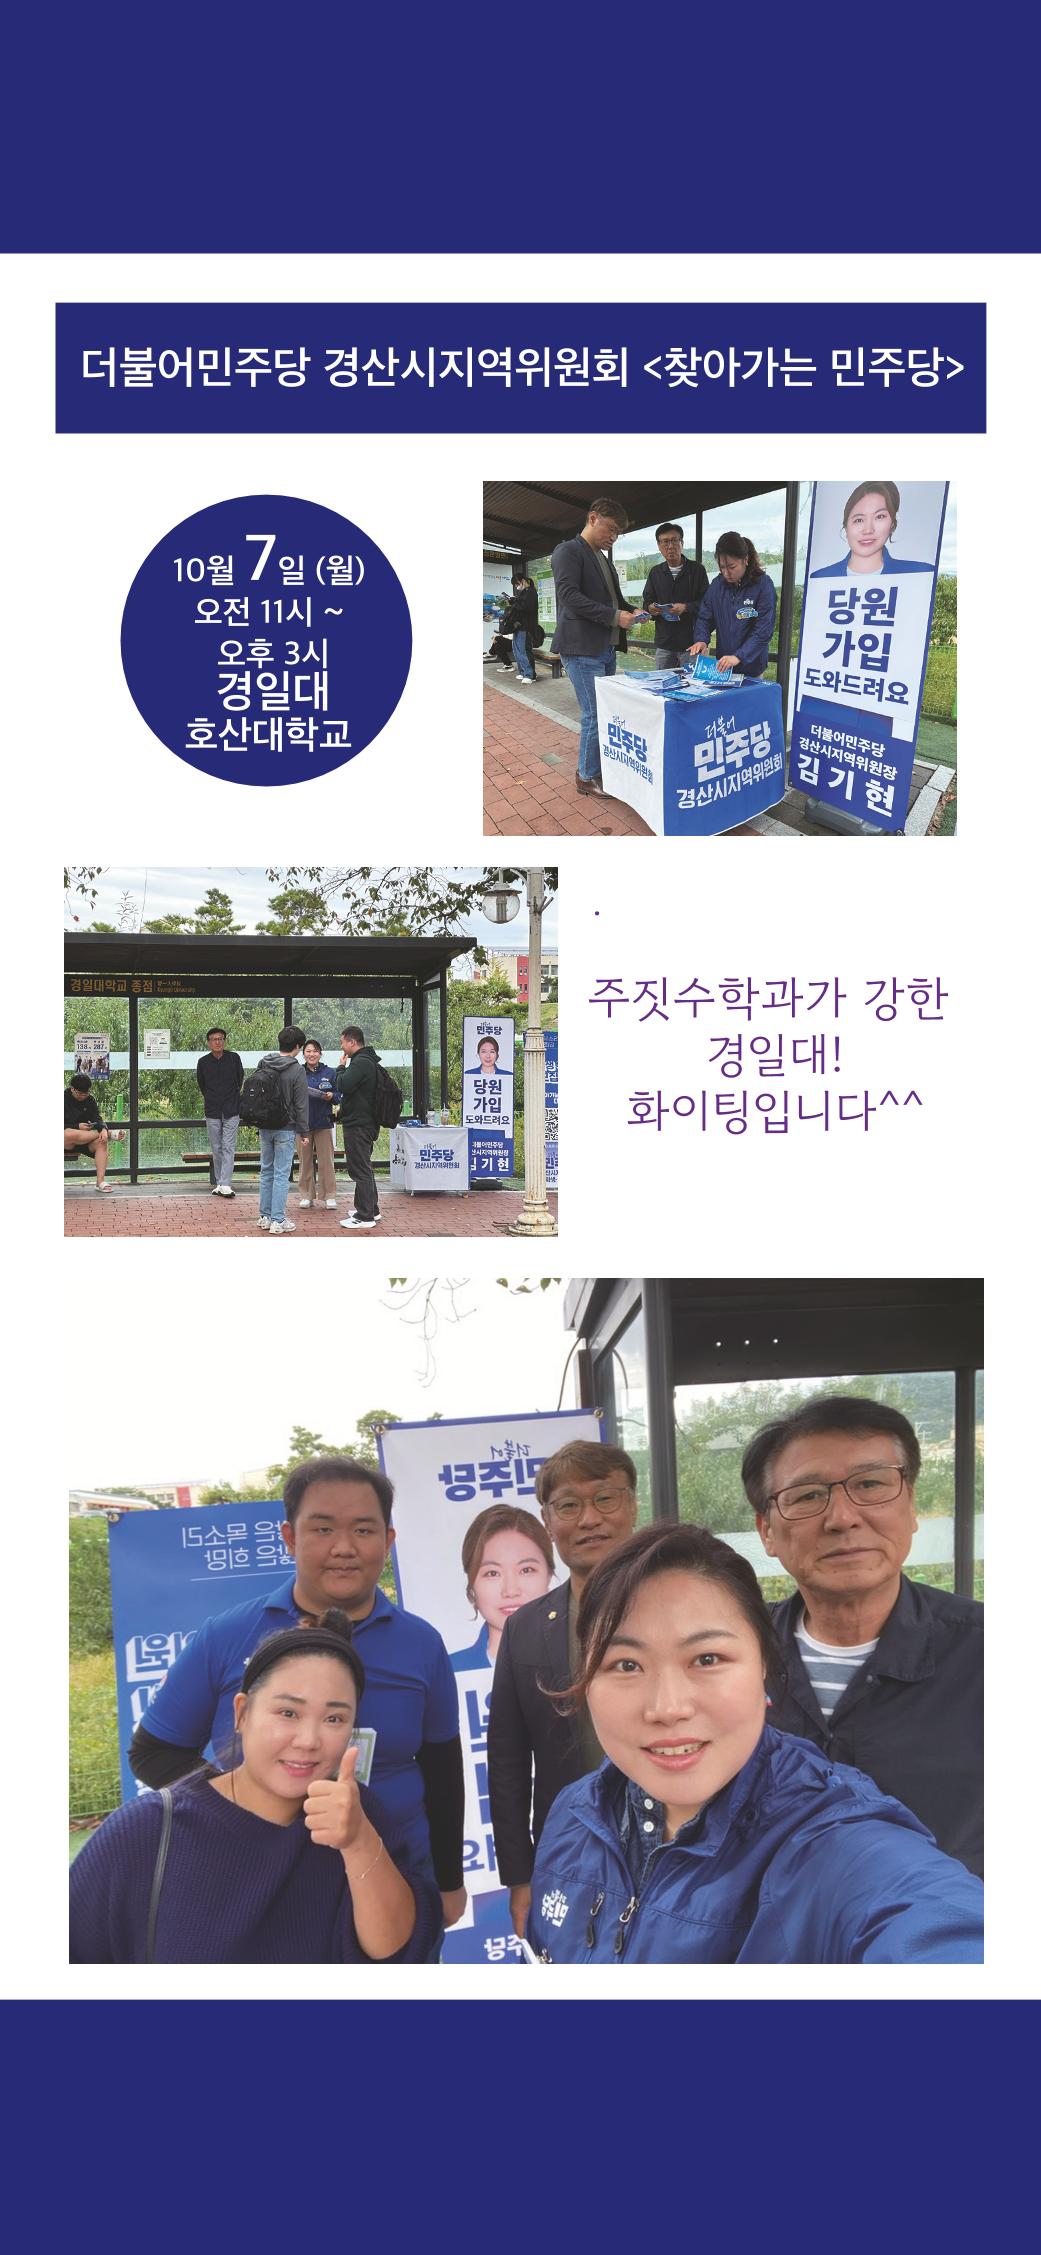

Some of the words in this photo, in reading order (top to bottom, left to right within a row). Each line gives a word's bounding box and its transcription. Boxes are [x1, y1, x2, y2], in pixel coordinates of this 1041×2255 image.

[829, 587, 898, 626] 당원
[822, 630, 892, 673] 가입
[803, 668, 909, 705] 도와드려요
[607, 722, 648, 763] 민주당
[704, 715, 737, 739] 더불어
[810, 724, 886, 758] 더불어민주당
[694, 720, 771, 783] 민주당
[798, 736, 898, 781] 경산시지역위원장
[676, 752, 783, 809] 경산시지역위원회
[476, 1025, 502, 1036] 민주당
[473, 1079, 502, 1095] 당원
[465, 1115, 511, 1125] 도와드려요
[473, 1097, 502, 1114] 가입
[419, 1149, 455, 1161] 민주당
